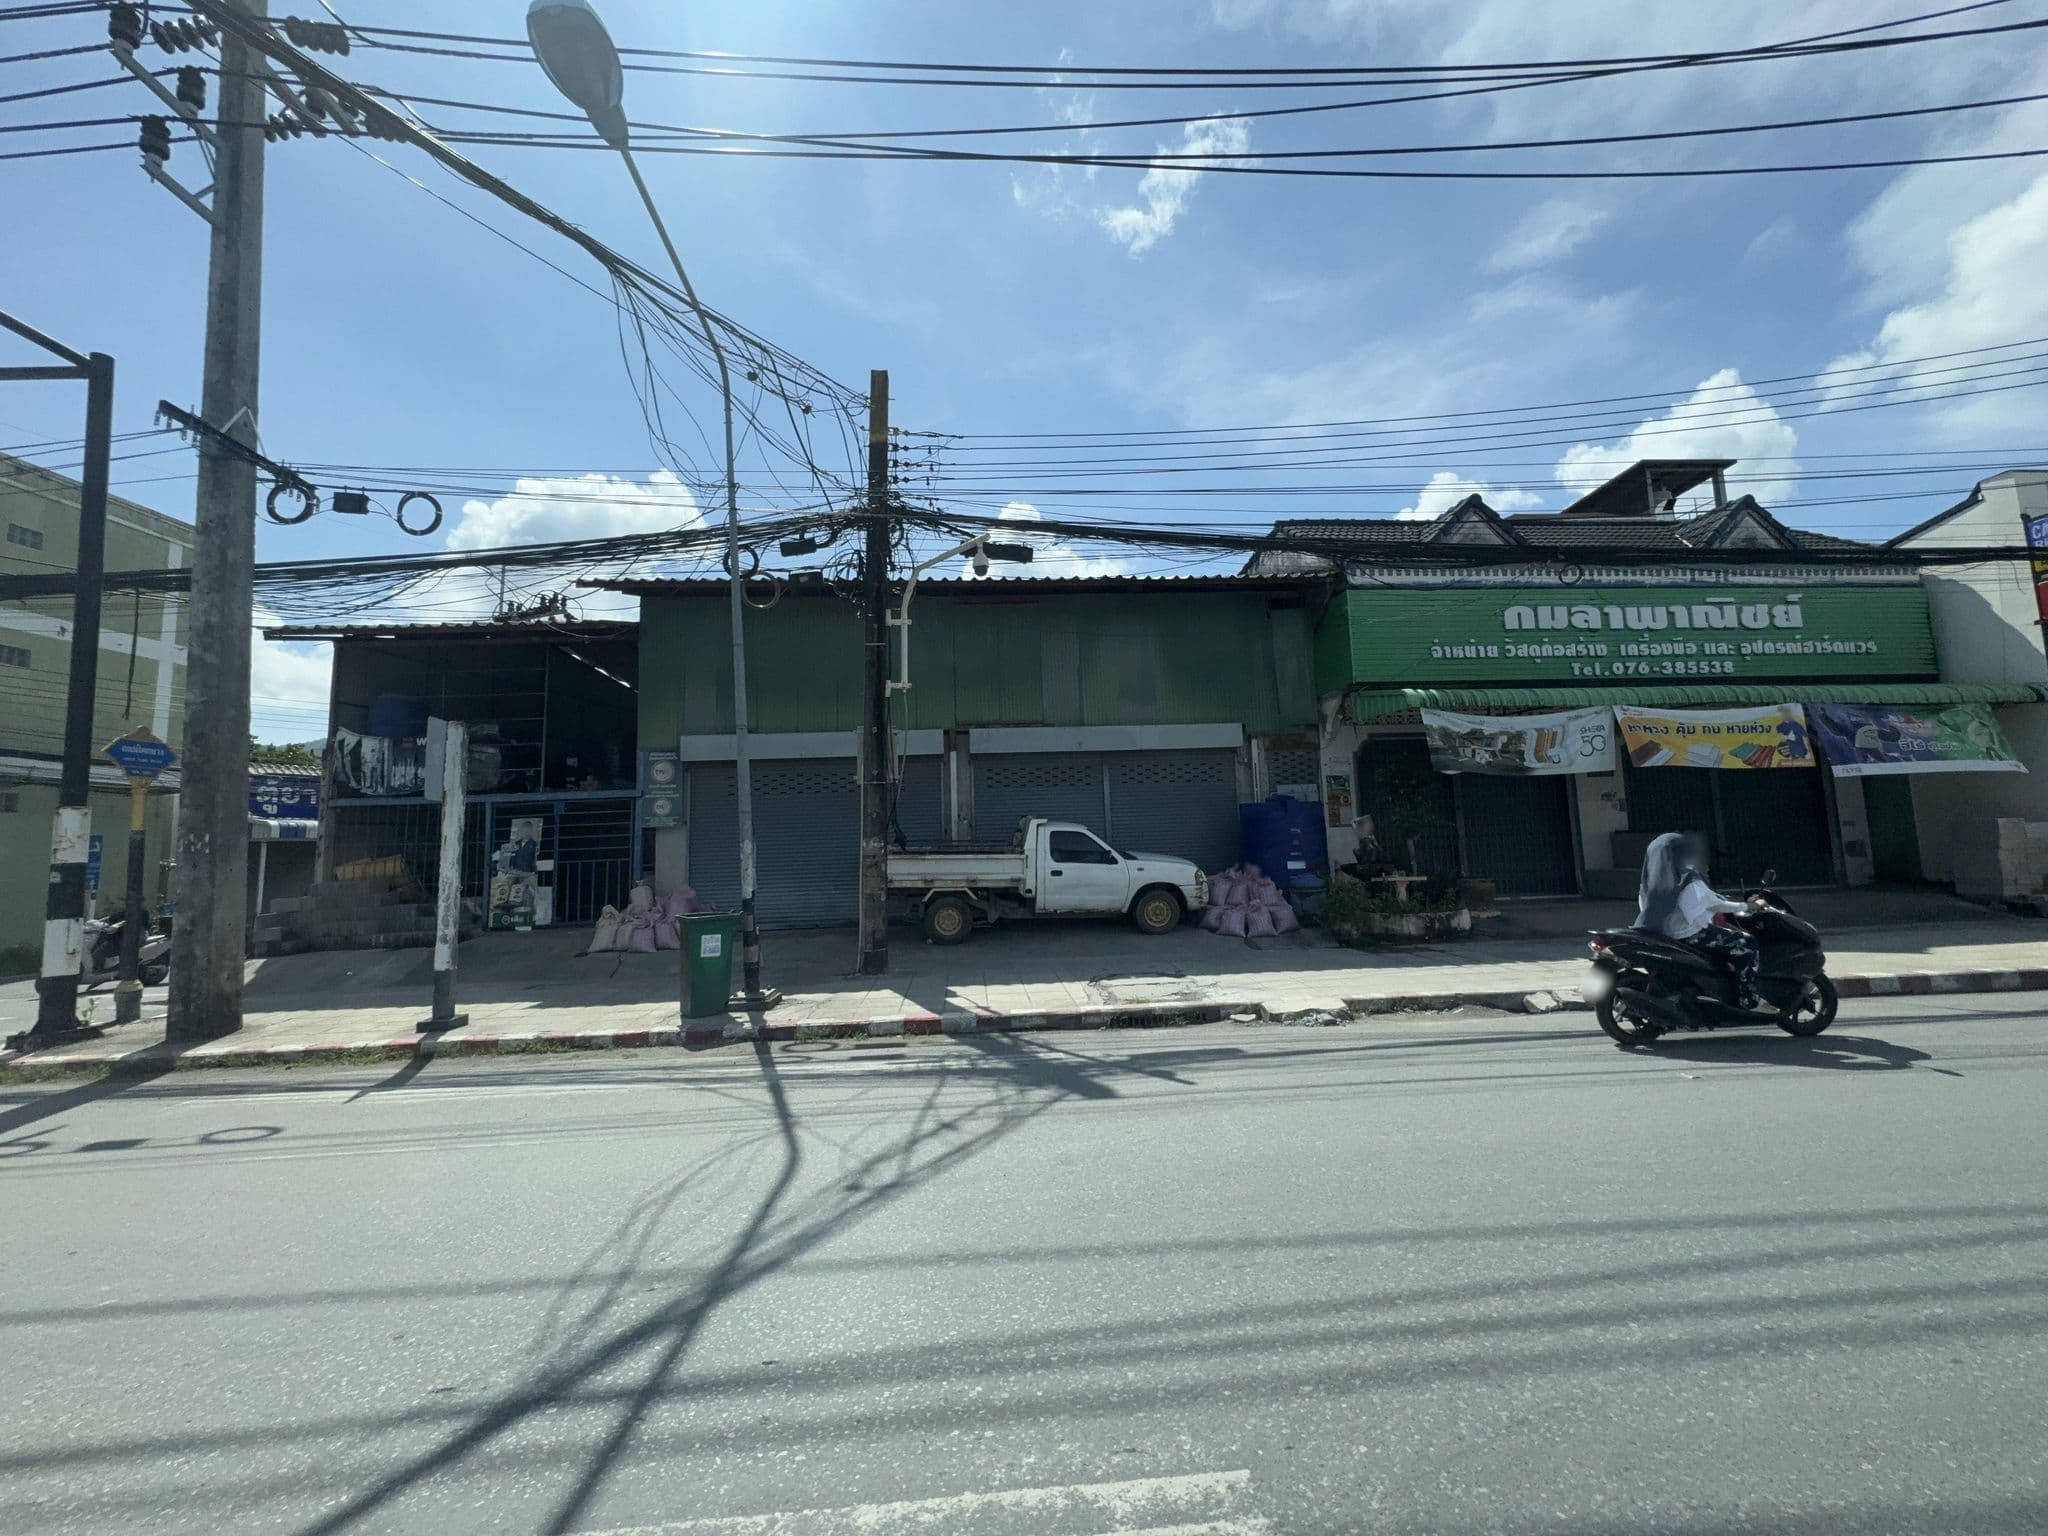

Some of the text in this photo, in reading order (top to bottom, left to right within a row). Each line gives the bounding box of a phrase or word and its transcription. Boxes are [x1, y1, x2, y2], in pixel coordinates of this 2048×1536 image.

[1504, 594, 1803, 630] กมลาพาณิชย์
[1431, 638, 1499, 658] จำหน่าย
[1505, 636, 1608, 663] วัสดุก่อสร้าง
[1620, 633, 1697, 657] เครื่องมือ
[1703, 641, 1735, 656] และ
[1726, 720, 1772, 734] หายห่วง
